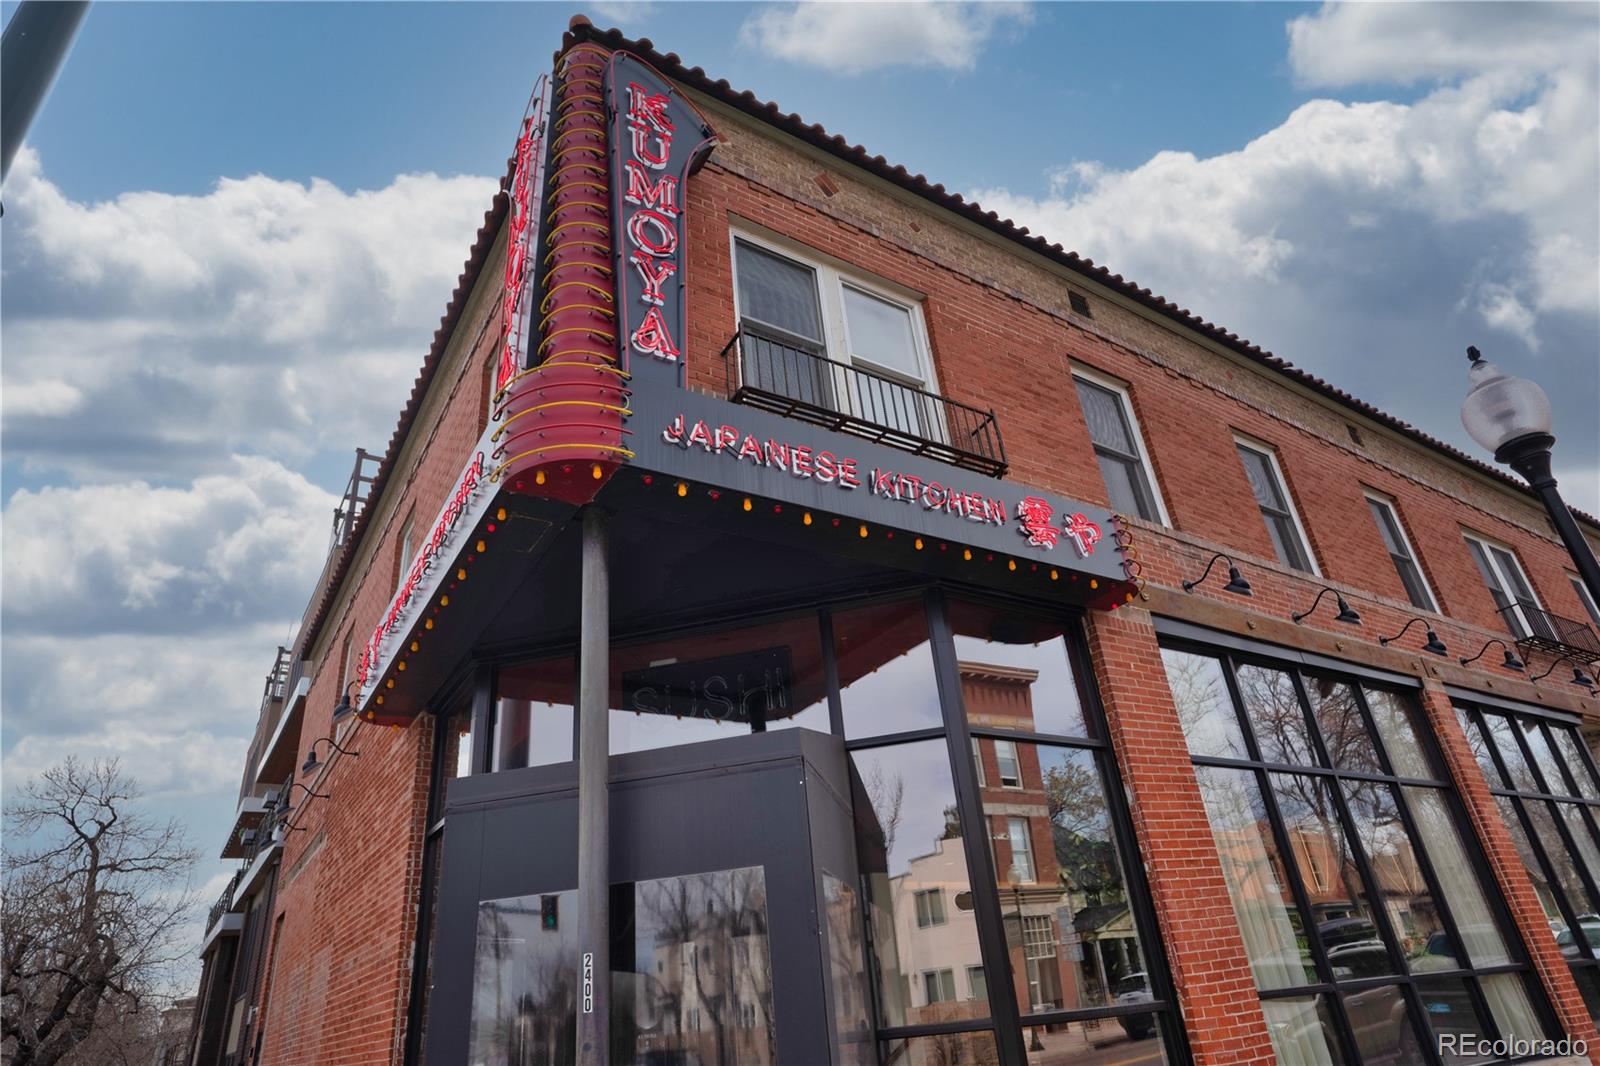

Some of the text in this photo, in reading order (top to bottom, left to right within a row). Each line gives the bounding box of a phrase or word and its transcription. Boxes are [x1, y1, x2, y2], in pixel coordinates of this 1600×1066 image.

[625, 82, 681, 361] KUMOYA
[663, 414, 1007, 526] JAPANESE KITCHEN
[584, 954, 592, 1012] 2400
